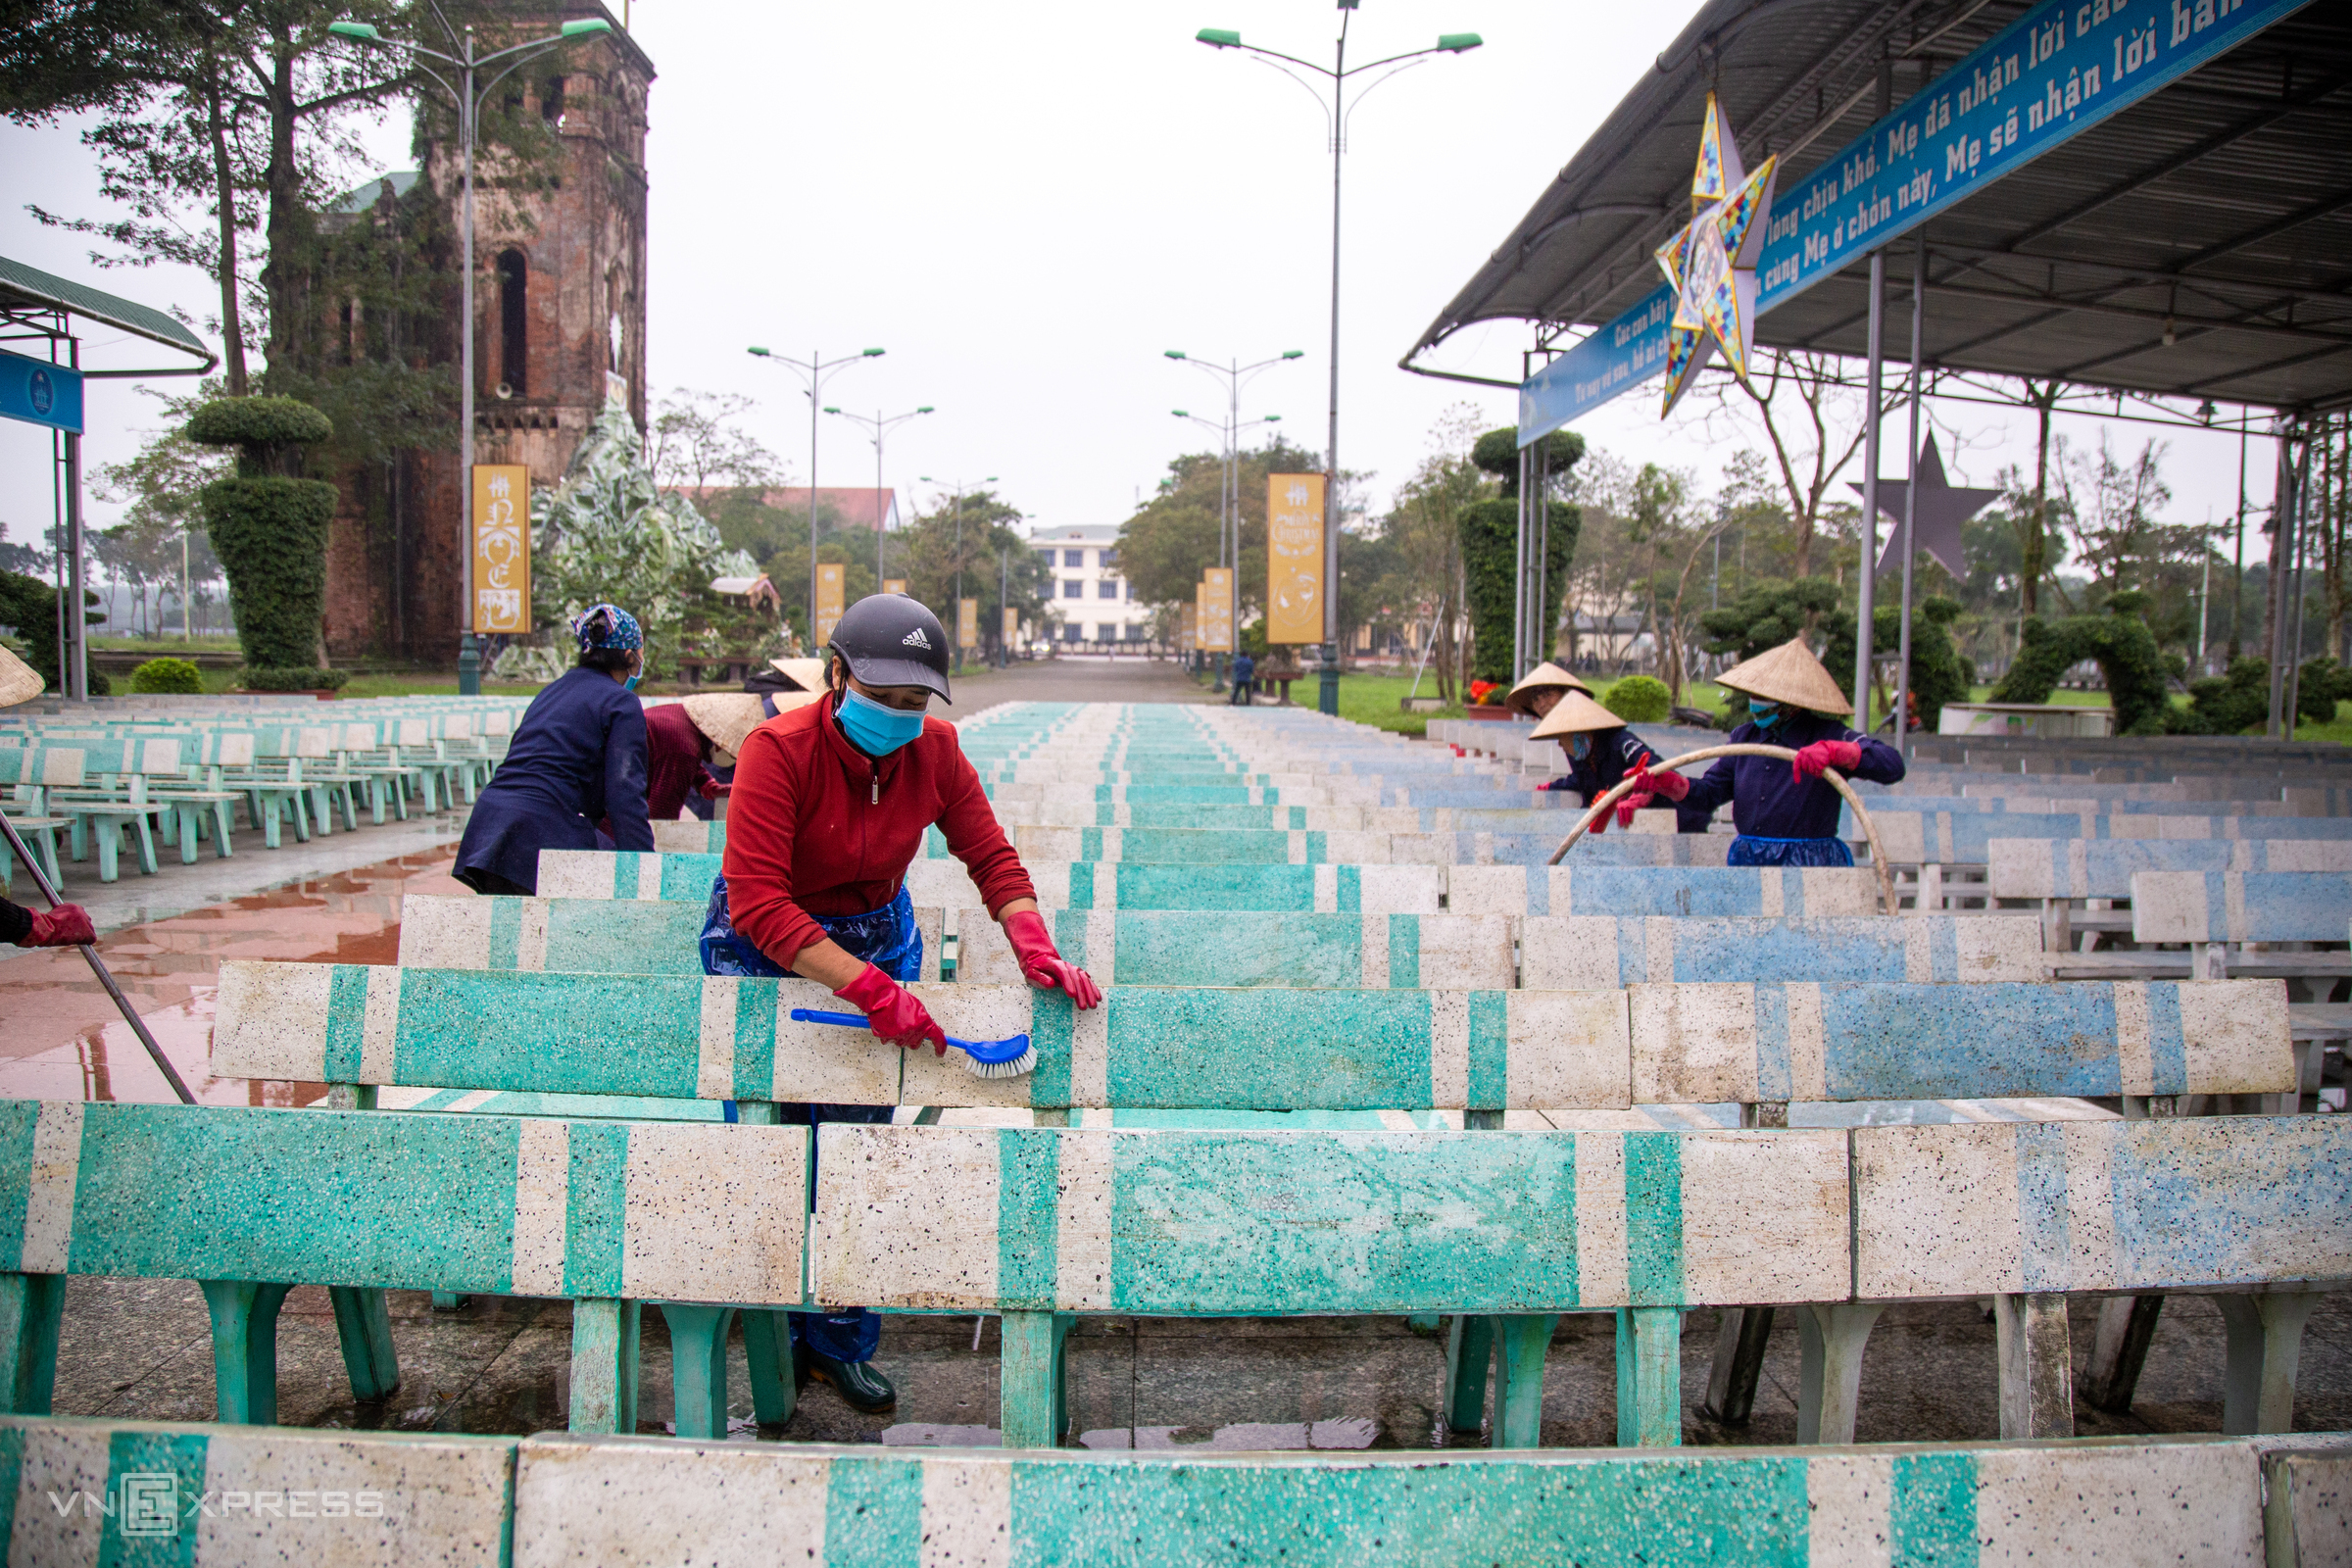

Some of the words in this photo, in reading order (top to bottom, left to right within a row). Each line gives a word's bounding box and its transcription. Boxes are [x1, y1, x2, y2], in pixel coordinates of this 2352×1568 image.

[1765, 252, 1800, 292] cùng
[1804, 230, 1829, 269] Mẹ
[1834, 217, 1844, 250] ở
[1848, 184, 1892, 241] chốn
[1897, 168, 1937, 211] này,
[1945, 134, 1982, 183] Mẹ
[1989, 105, 2019, 157] sẽ
[2029, 64, 2101, 133] nhận
[2112, 16, 2157, 83] lời
[1767, 208, 1799, 246] lòng
[1803, 178, 1838, 221] chịu
[1842, 134, 1881, 195] khổ.
[1887, 121, 1919, 166] Mẹ
[1925, 92, 1951, 139] đã
[1959, 55, 2020, 118] nhận
[2029, 9, 2066, 71] lời
[902, 638, 932, 651] adidas
